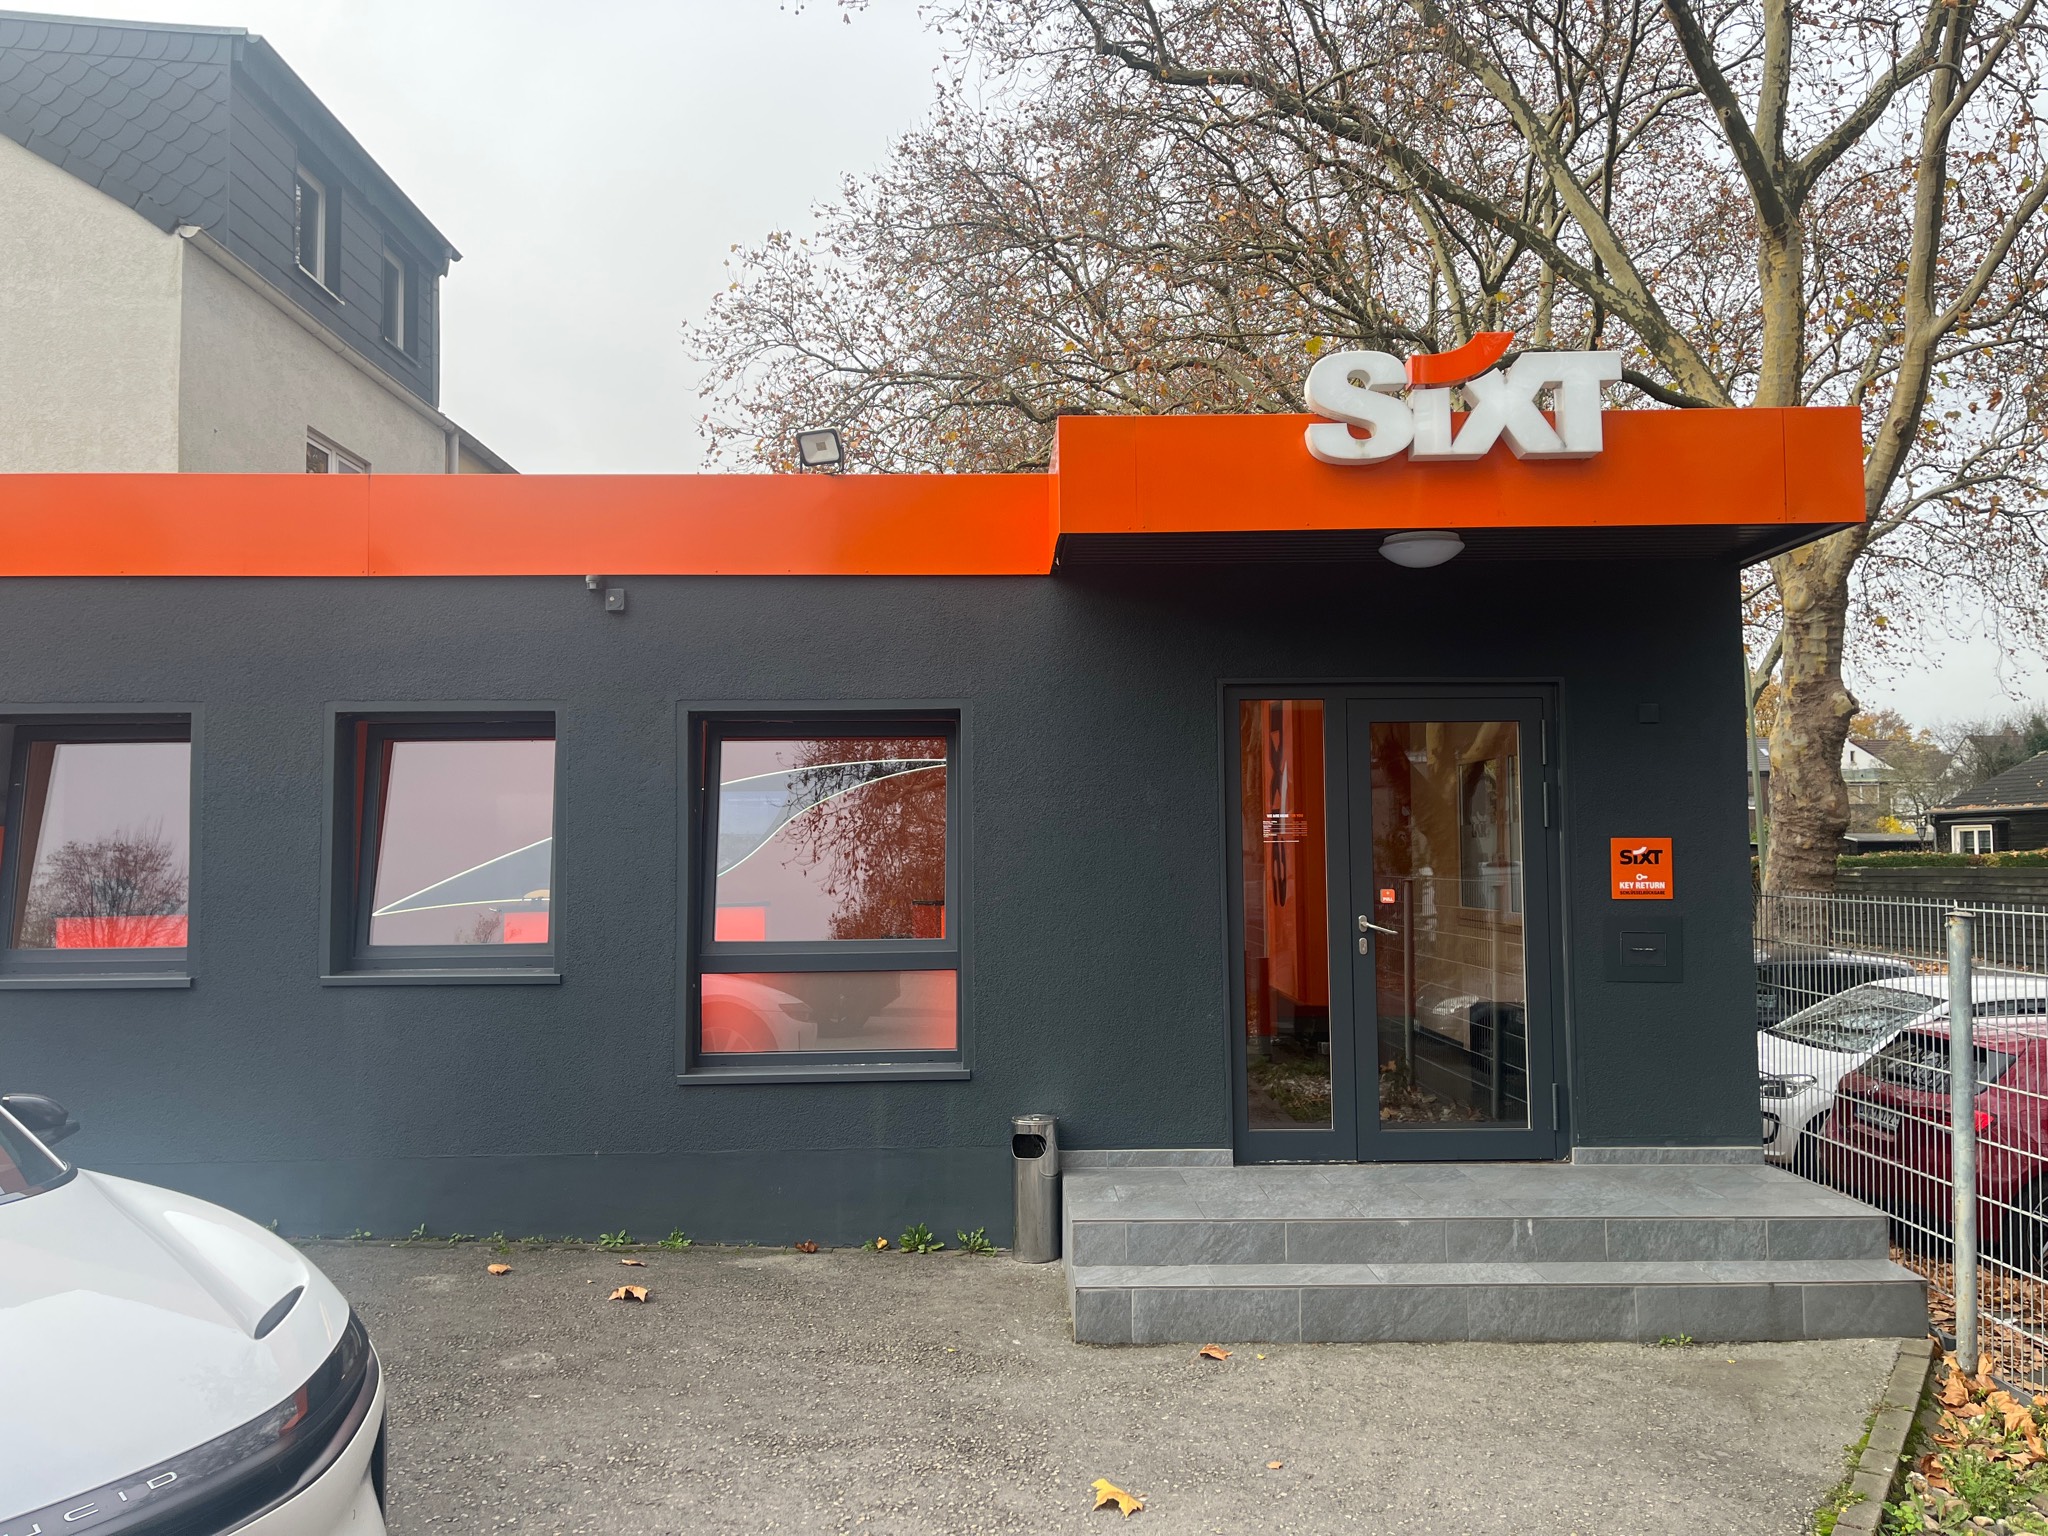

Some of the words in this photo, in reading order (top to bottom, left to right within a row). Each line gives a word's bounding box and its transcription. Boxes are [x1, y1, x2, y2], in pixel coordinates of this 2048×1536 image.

[1304, 331, 1624, 466] SIXT
[1620, 847, 1663, 864] SIXT
[1619, 881, 1634, 889] KEY
[1635, 881, 1665, 889] RETURN
